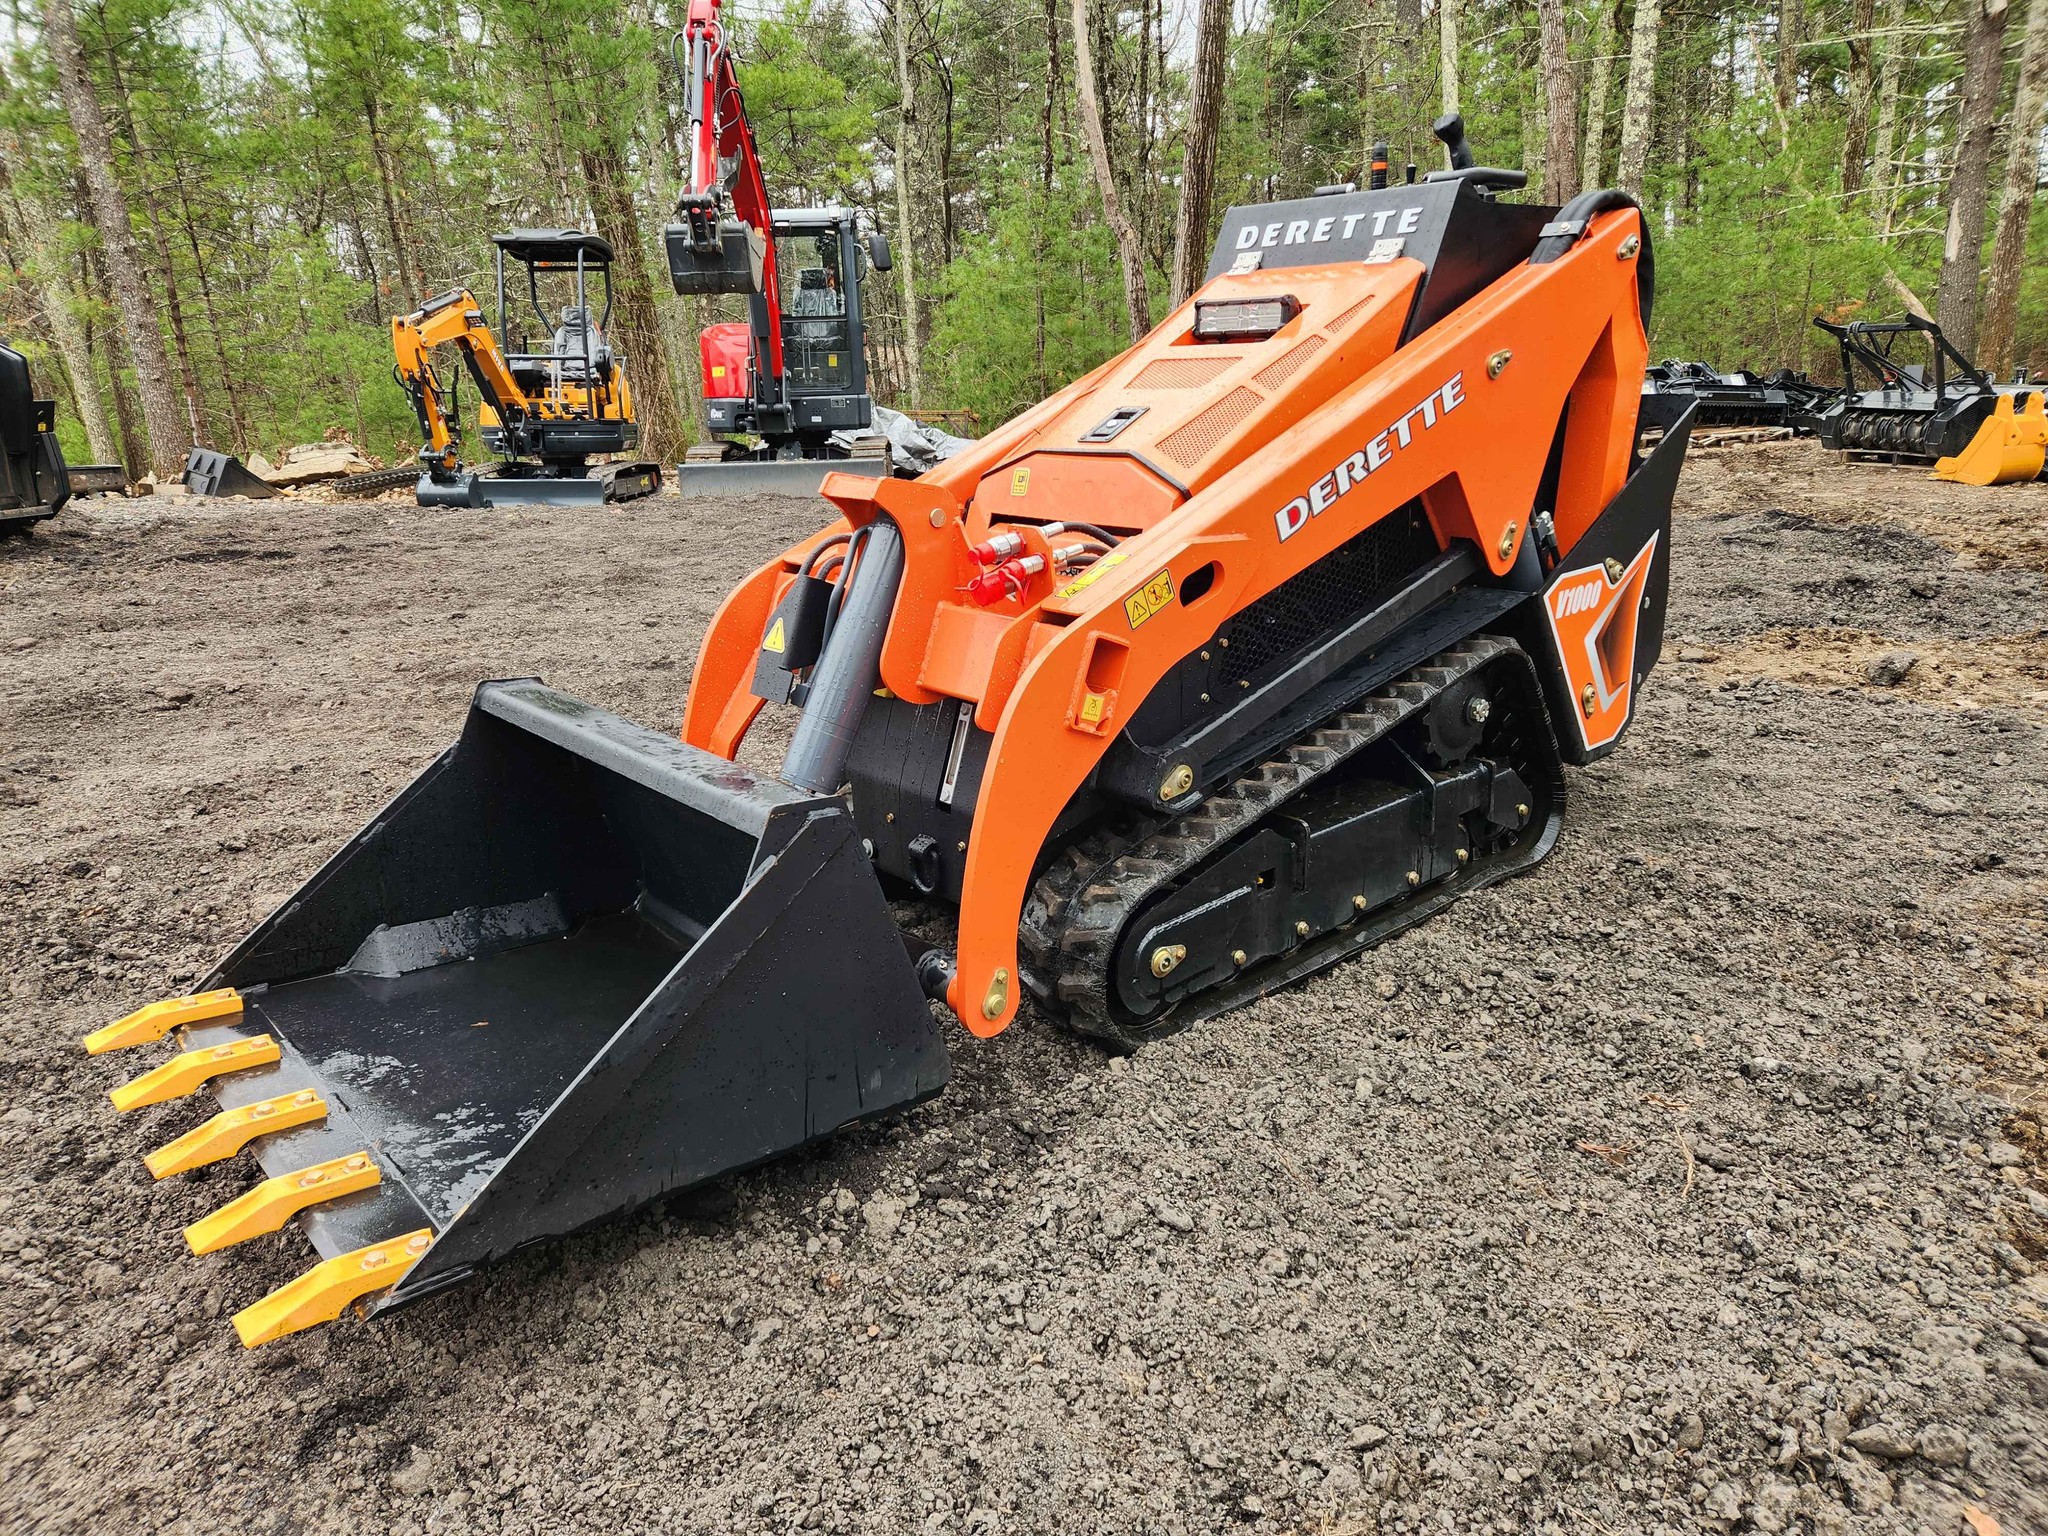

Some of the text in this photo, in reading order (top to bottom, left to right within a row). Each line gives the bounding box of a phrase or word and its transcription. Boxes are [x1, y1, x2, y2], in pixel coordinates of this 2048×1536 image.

[1236, 207, 1423, 250] DERETTE
[1274, 370, 1466, 544] DERETTE
[1555, 579, 1602, 619] V1000
